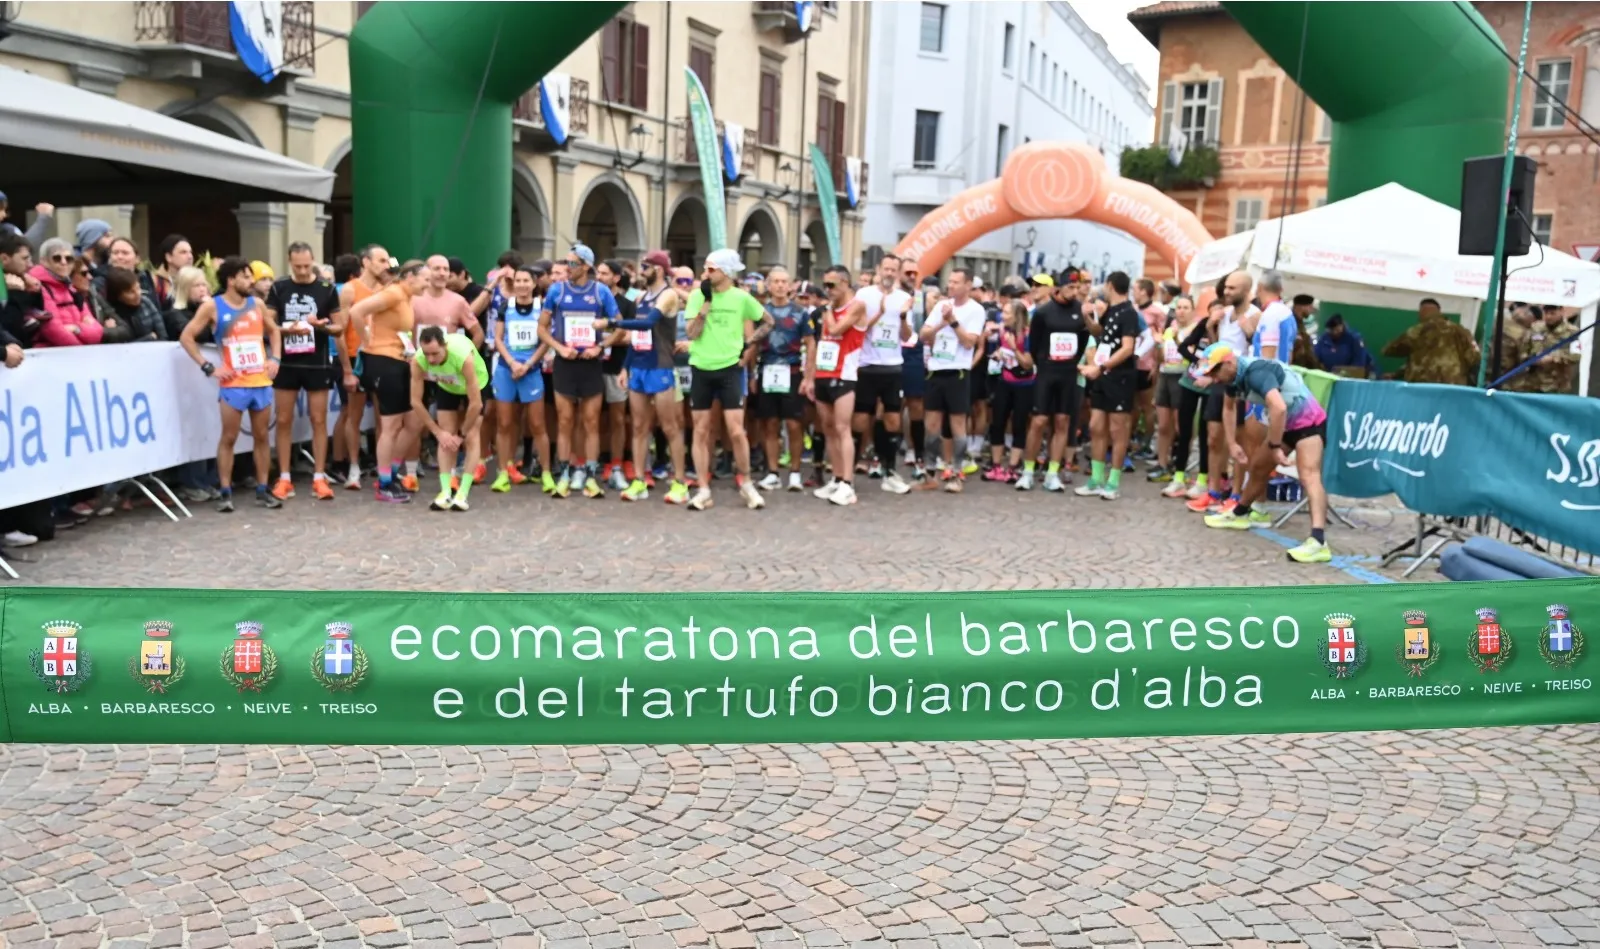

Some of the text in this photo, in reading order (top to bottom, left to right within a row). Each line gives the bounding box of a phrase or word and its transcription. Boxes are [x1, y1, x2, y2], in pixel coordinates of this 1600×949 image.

[963, 194, 996, 222] CRC
[1104, 191, 1200, 262] FONDAZIONE
[516, 331, 531, 340] 101
[882, 329, 891, 339] 72
[65, 379, 156, 457] Alba
[390, 609, 1299, 661] ecomaratona del barbaresco
[433, 687, 464, 719] e
[495, 676, 583, 719] del
[615, 675, 838, 719] tartufo
[868, 674, 1063, 716] bianco
[1310, 678, 1592, 700] ALBA BARBARESCO NEIVE TREISO
[28, 703, 378, 714] ALBA BARBARESCO NEIVE TREISO
